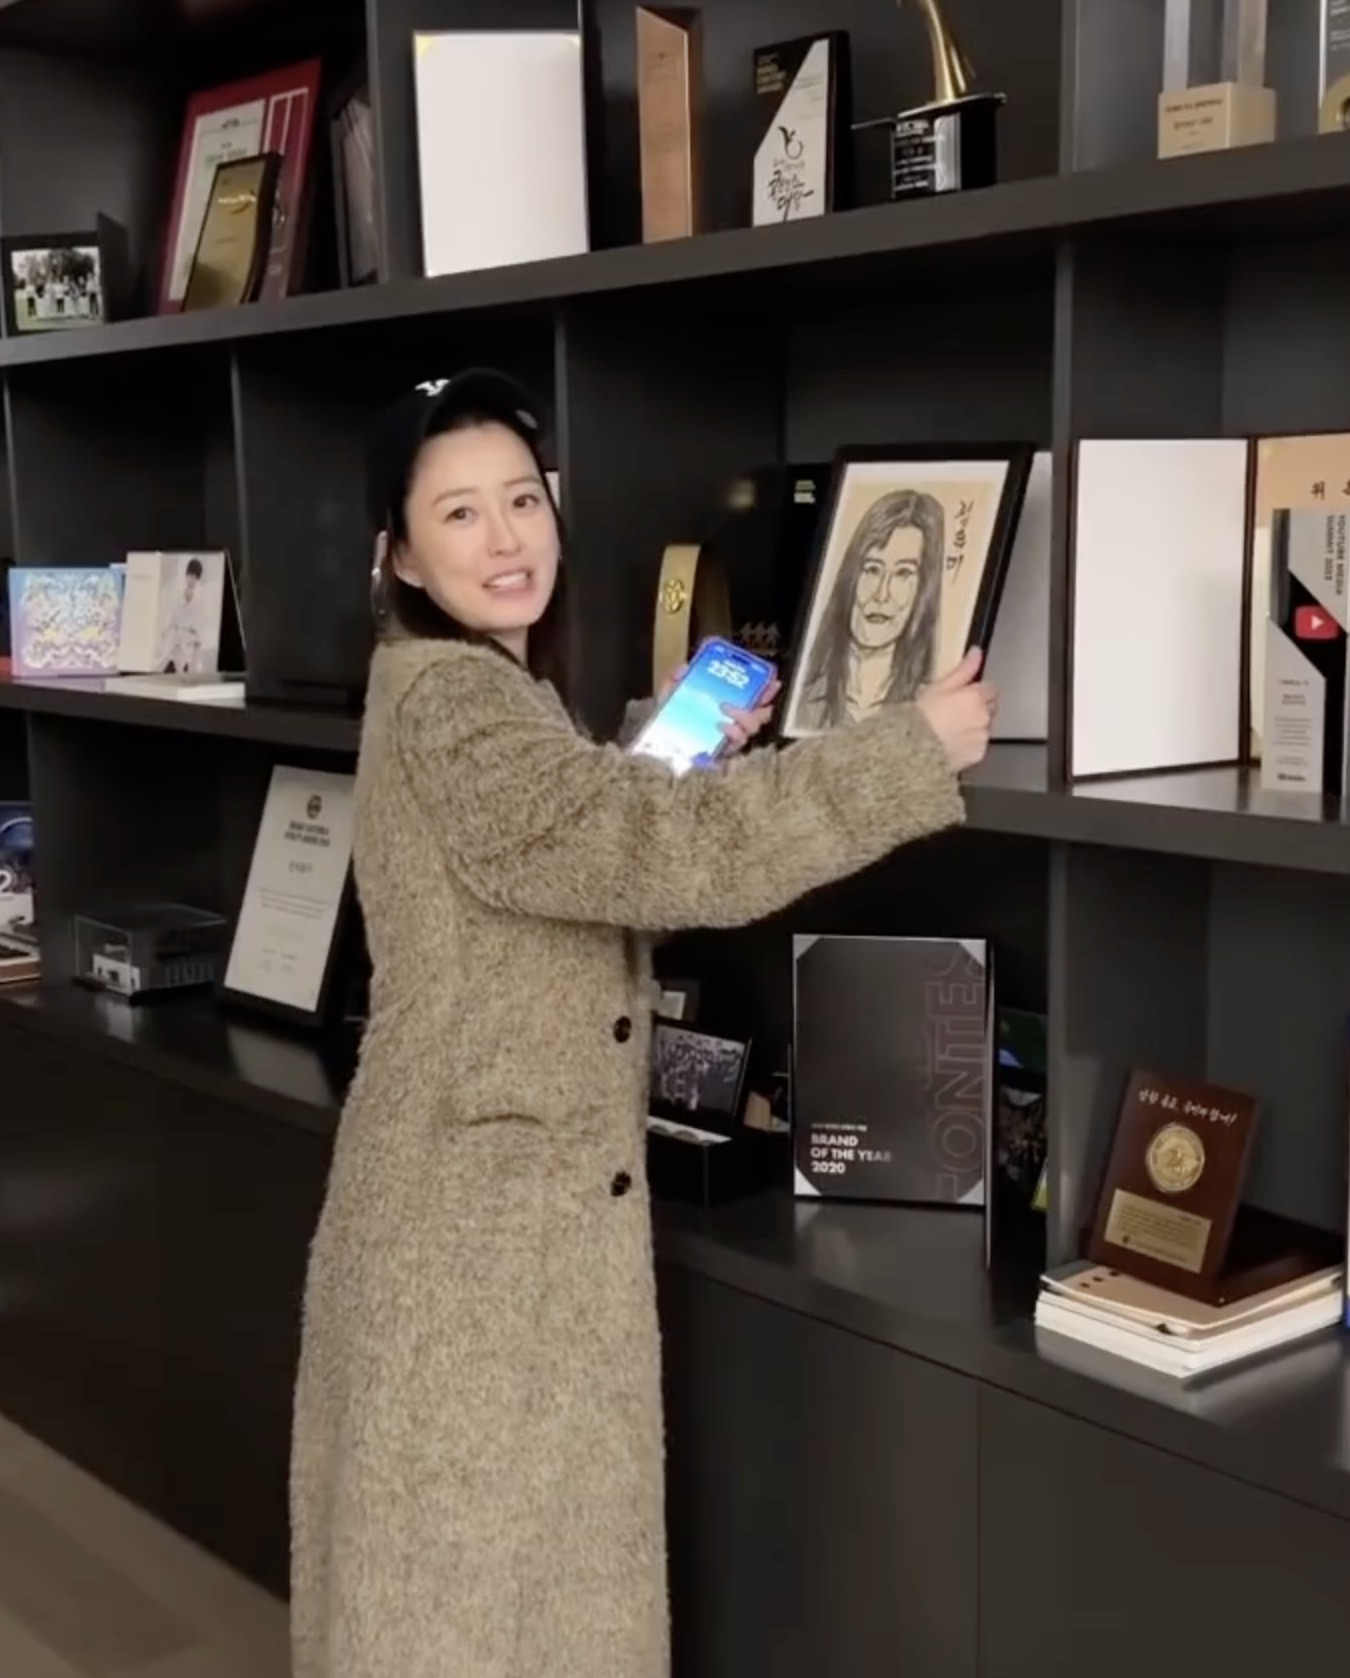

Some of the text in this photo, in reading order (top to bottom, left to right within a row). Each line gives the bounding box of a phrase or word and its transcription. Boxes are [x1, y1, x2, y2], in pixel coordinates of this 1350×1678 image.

[811, 1133, 859, 1147] BRAND
[810, 1147, 892, 1163] OF THE YEAR
[811, 1161, 846, 1174] 2020
